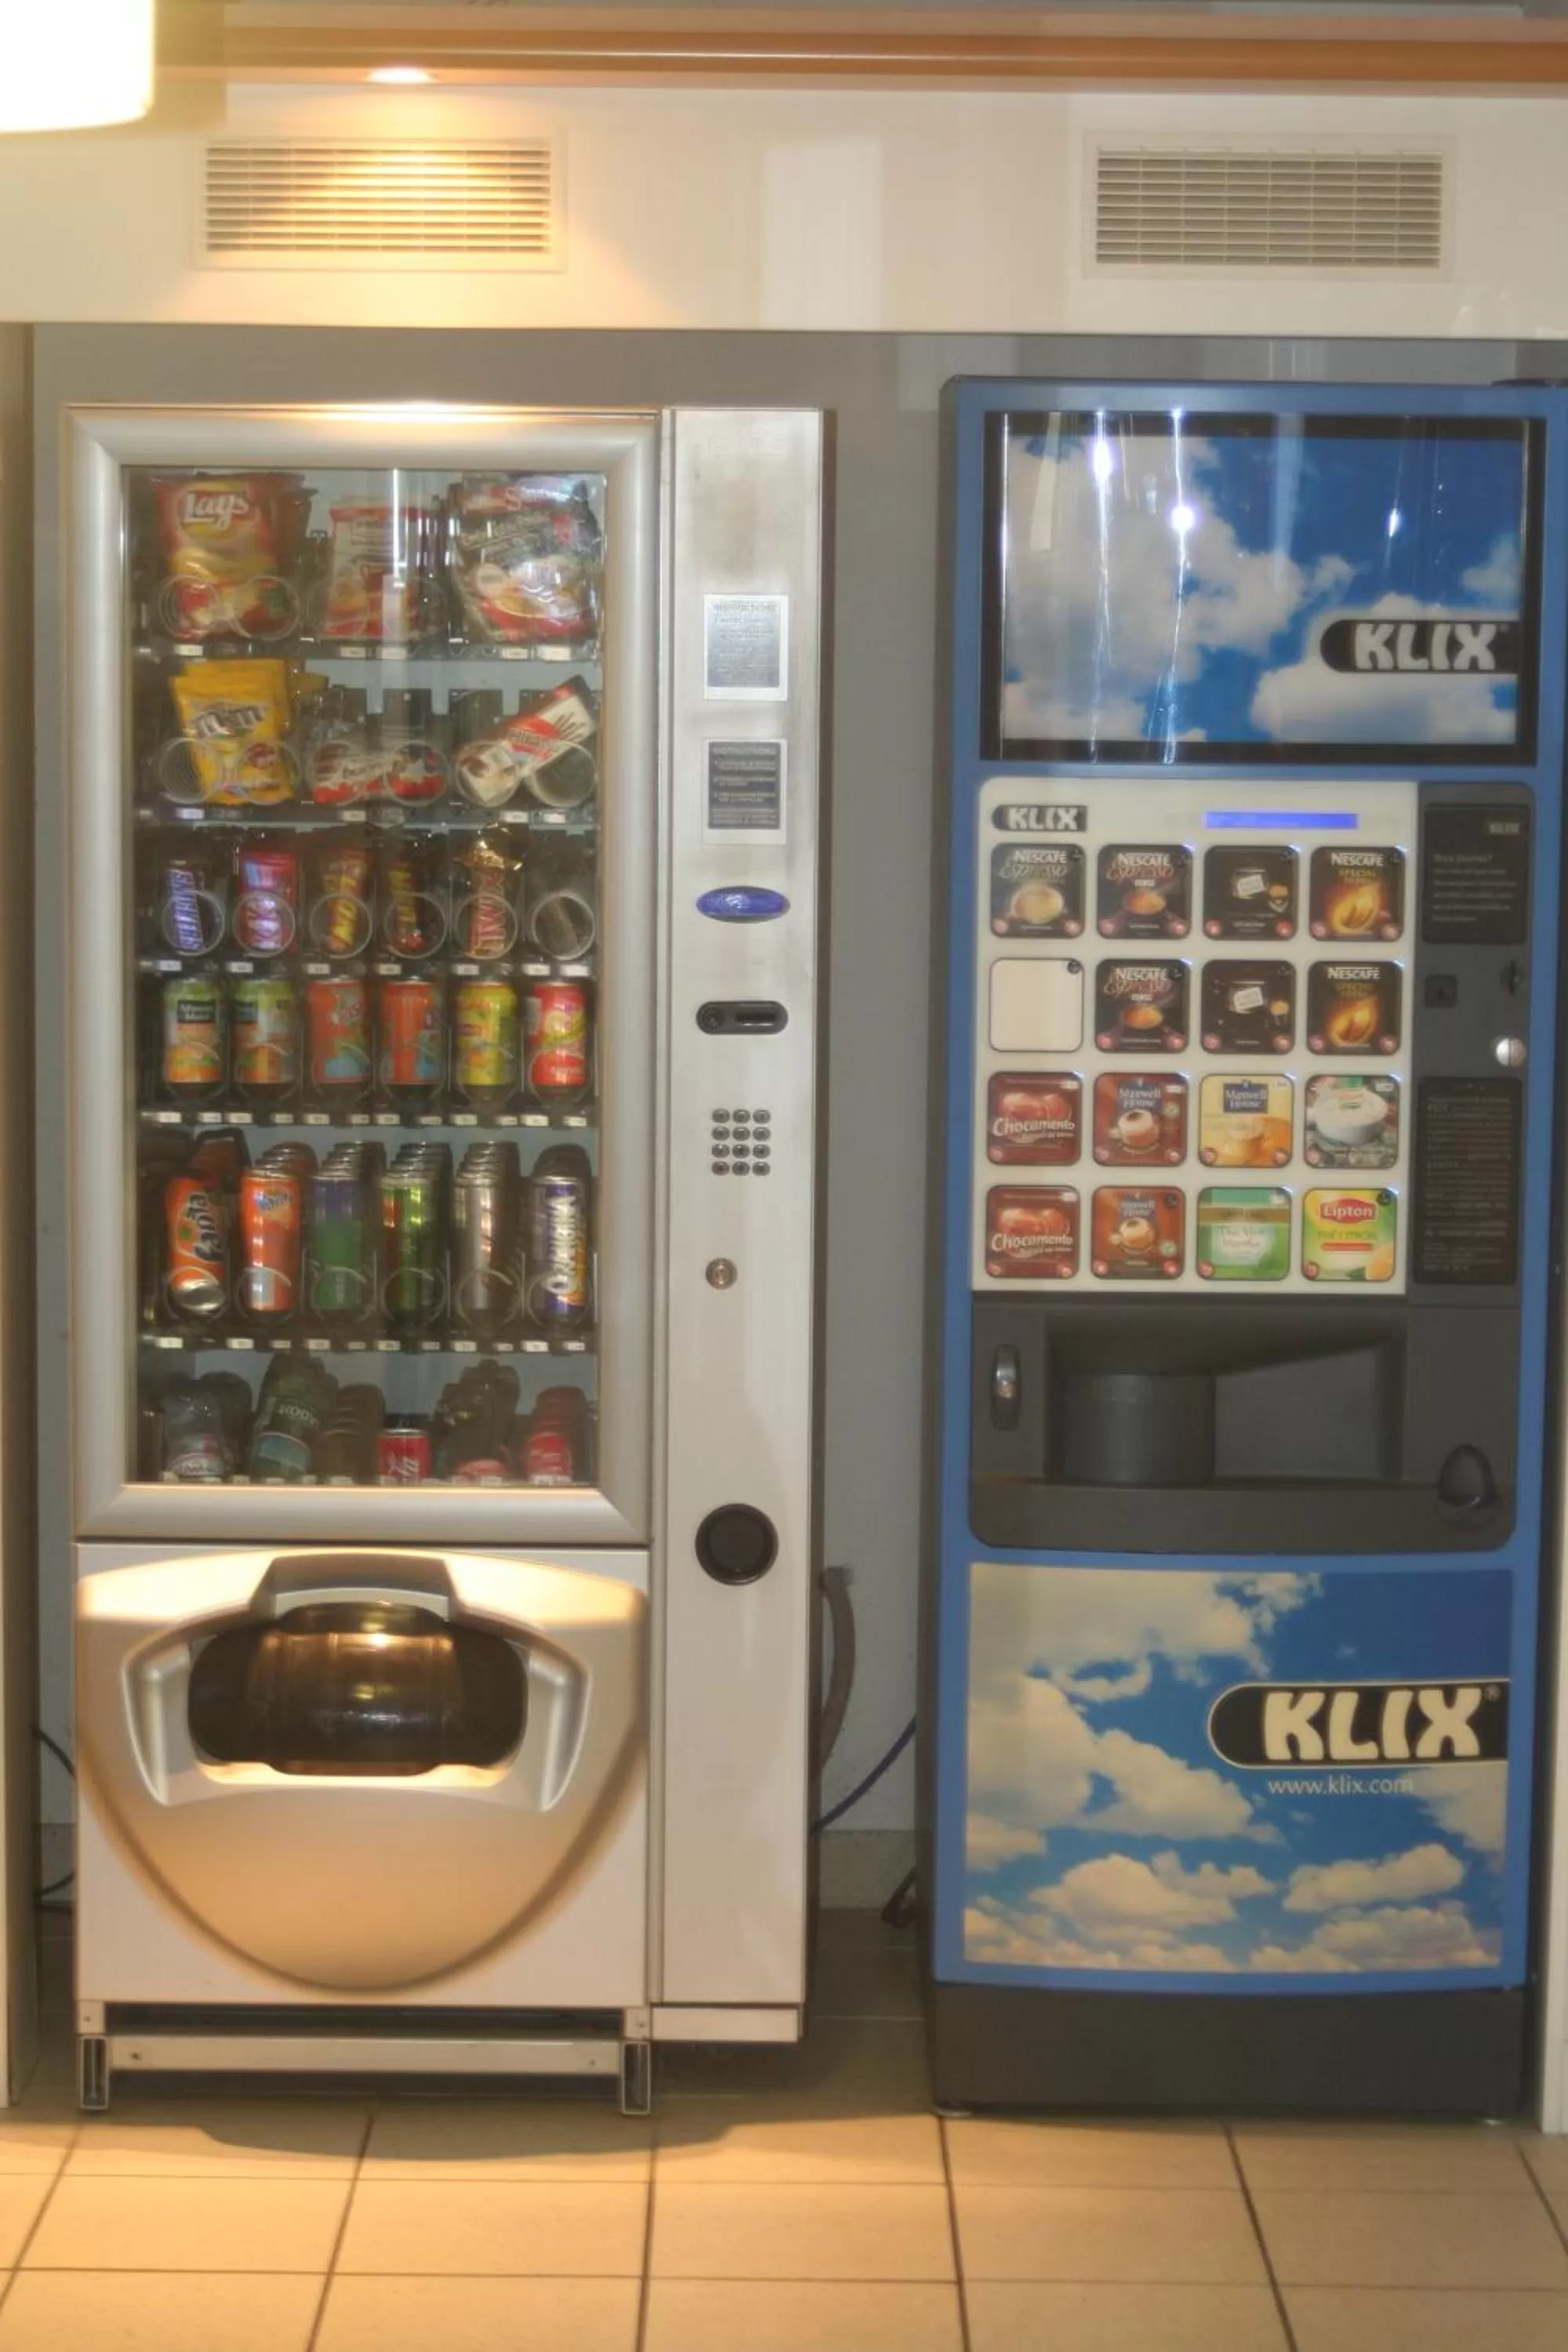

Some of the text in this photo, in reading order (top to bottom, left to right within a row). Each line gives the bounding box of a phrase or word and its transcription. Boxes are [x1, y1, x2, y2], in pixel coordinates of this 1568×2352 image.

[1355, 623, 1496, 670] KLIX
[1008, 806, 1078, 830] KLIX
[1323, 1206, 1374, 1221] Lipton
[1264, 1687, 1483, 1761] KLIX
[1268, 1774, 1414, 1796] www.klix.com
